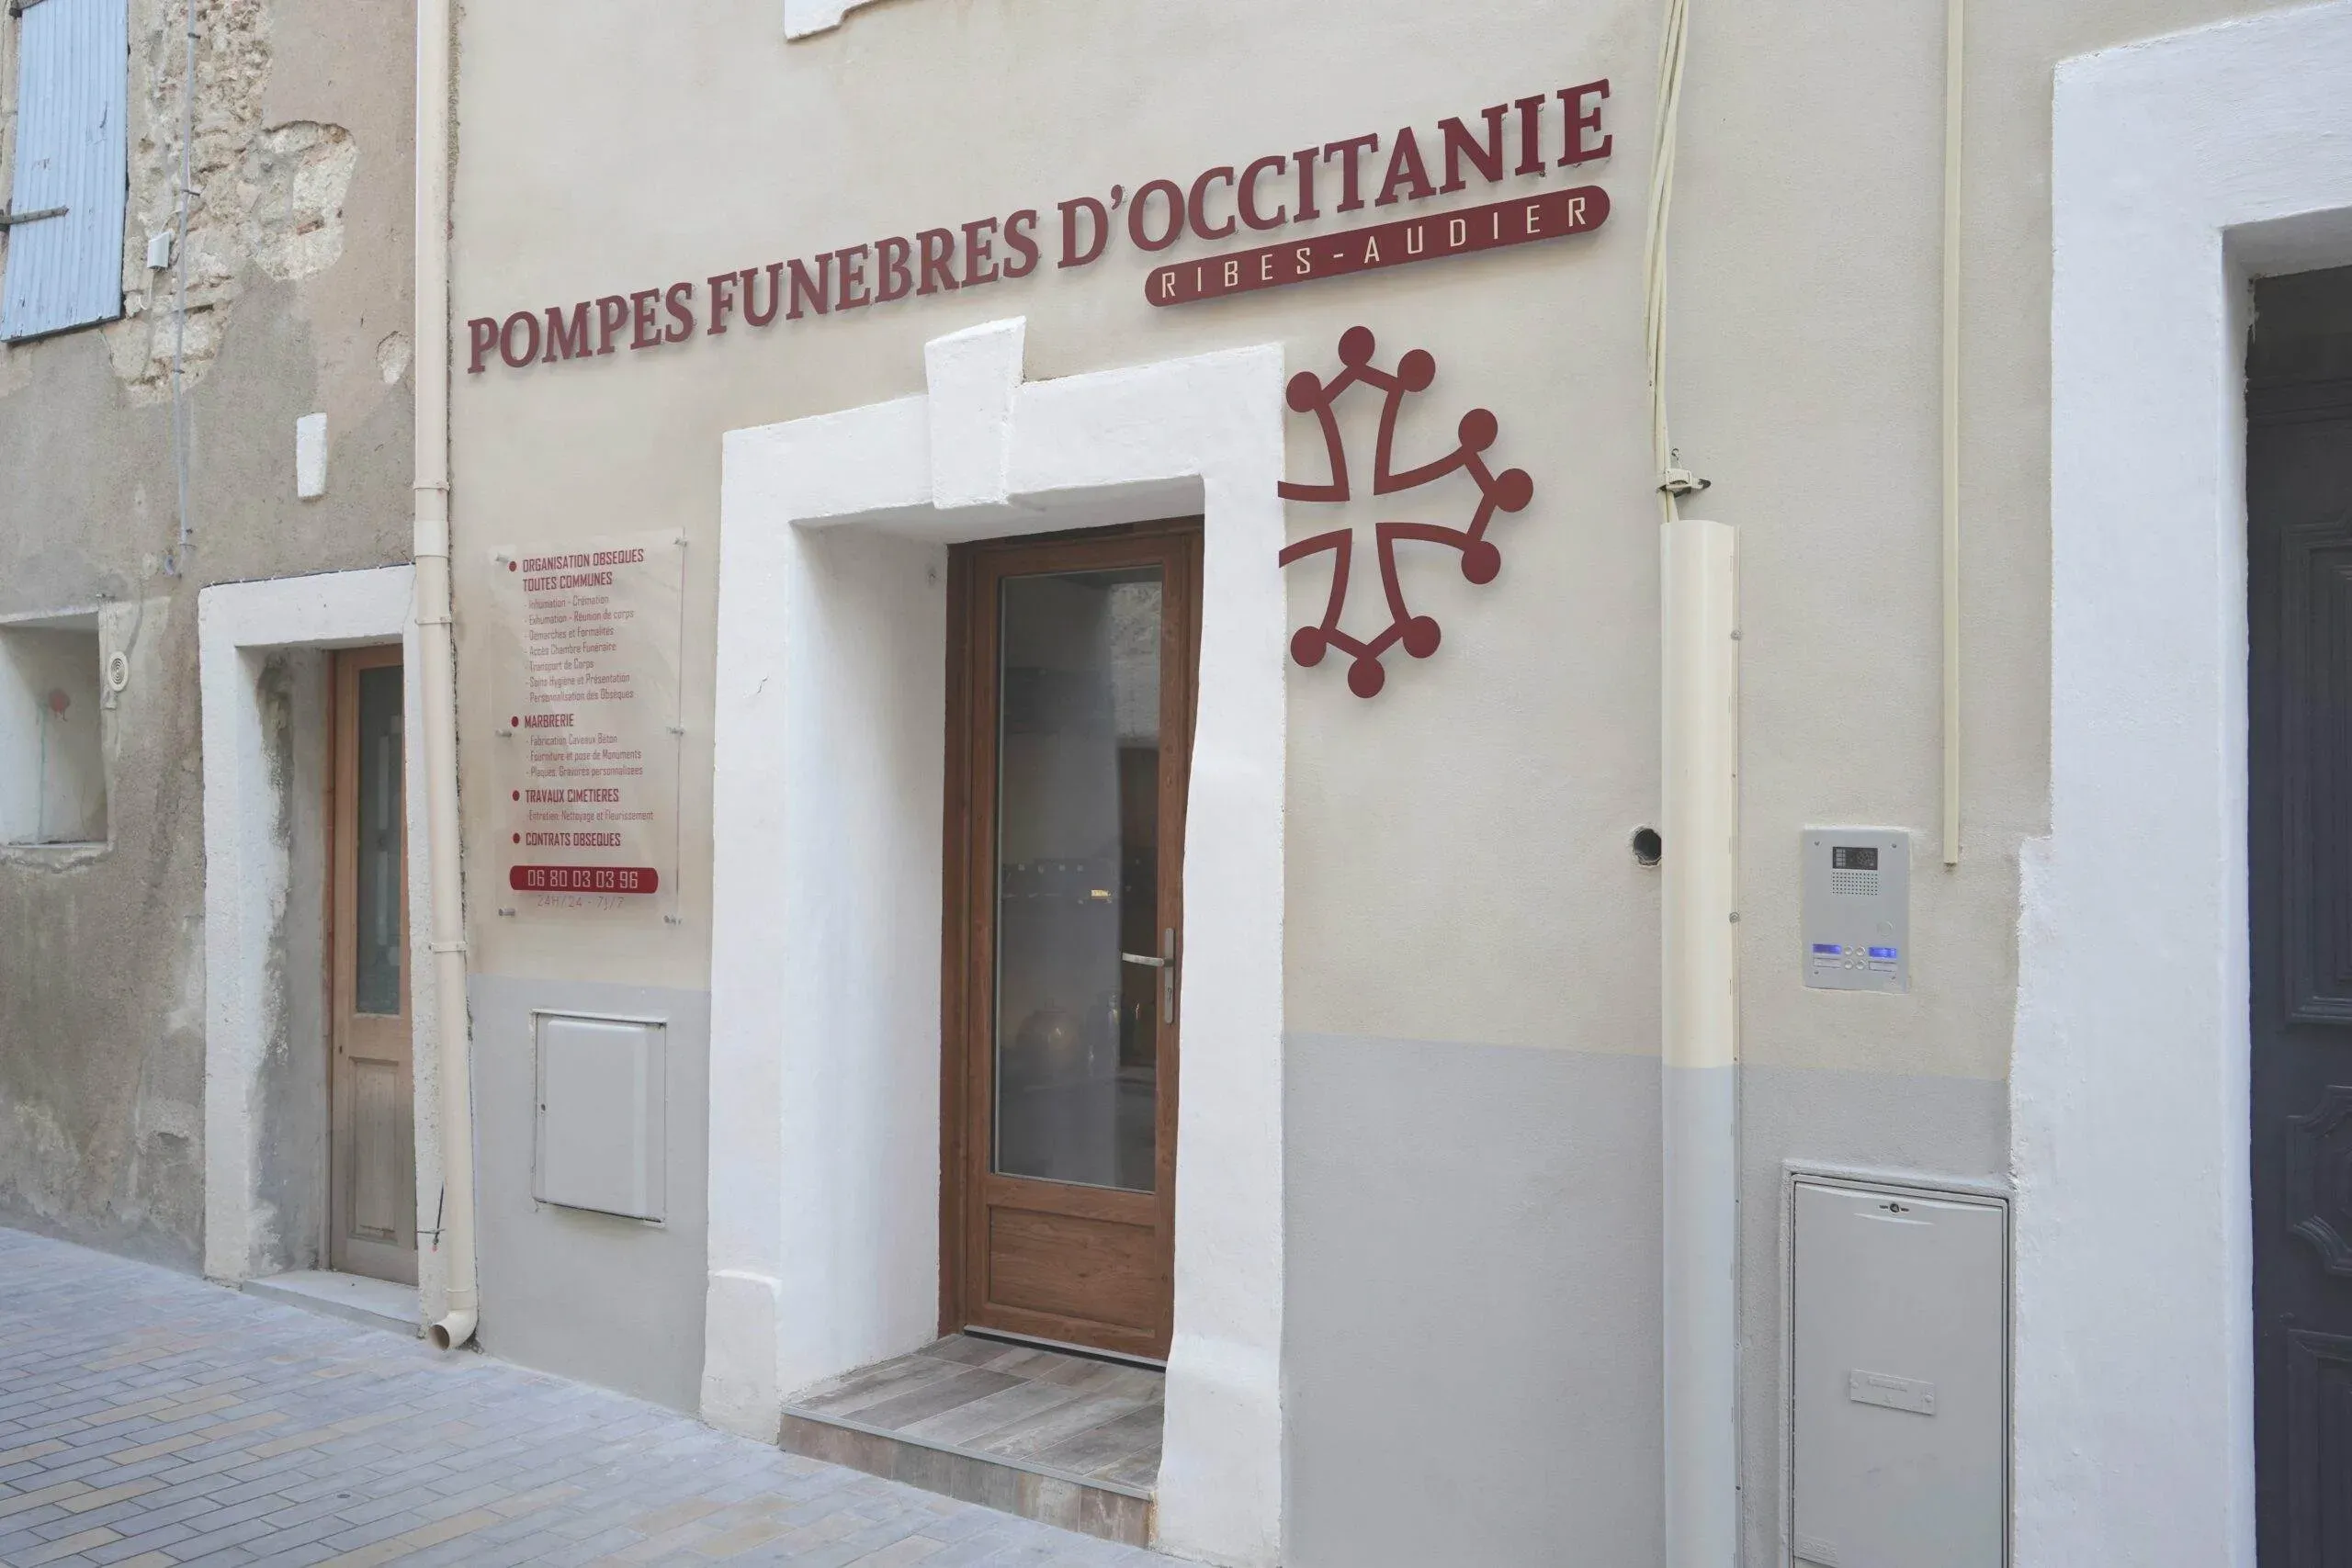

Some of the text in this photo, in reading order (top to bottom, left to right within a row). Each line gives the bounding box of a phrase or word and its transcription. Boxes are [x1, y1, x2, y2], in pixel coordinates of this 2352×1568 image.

[467, 78, 1613, 374] POMPES FUNEBRES D'OCCITANIE
[1161, 197, 1588, 299] RIBES-AUDIER
[522, 548, 644, 572] ORGANISATION OBSEQUES
[522, 571, 613, 592] TOUTES COMMUNES
[529, 598, 566, 610] Inhumation
[529, 614, 567, 625] Exhumation
[603, 608, 612, 619] de
[614, 610, 635, 620] corps
[568, 629, 575, 638] et
[551, 643, 582, 655] Chambre
[530, 658, 594, 672] Transport de Corps
[577, 676, 584, 685] et
[586, 690, 598, 701] des
[525, 714, 574, 728] MARBRERIE
[530, 735, 566, 746] Fabrication
[569, 734, 595, 745] Caveaux
[530, 749, 641, 763] Fourniture et pose de Monuments
[559, 765, 590, 777] Gravures
[526, 788, 619, 803] TRAVAUX CIMETIERES
[561, 809, 594, 823] Nettoyage
[596, 810, 604, 820] et
[605, 808, 654, 821] Fleurissement
[526, 832, 621, 846] CONTRATS OBSEQUES
[527, 869, 639, 889] 06 80 03 03 96
